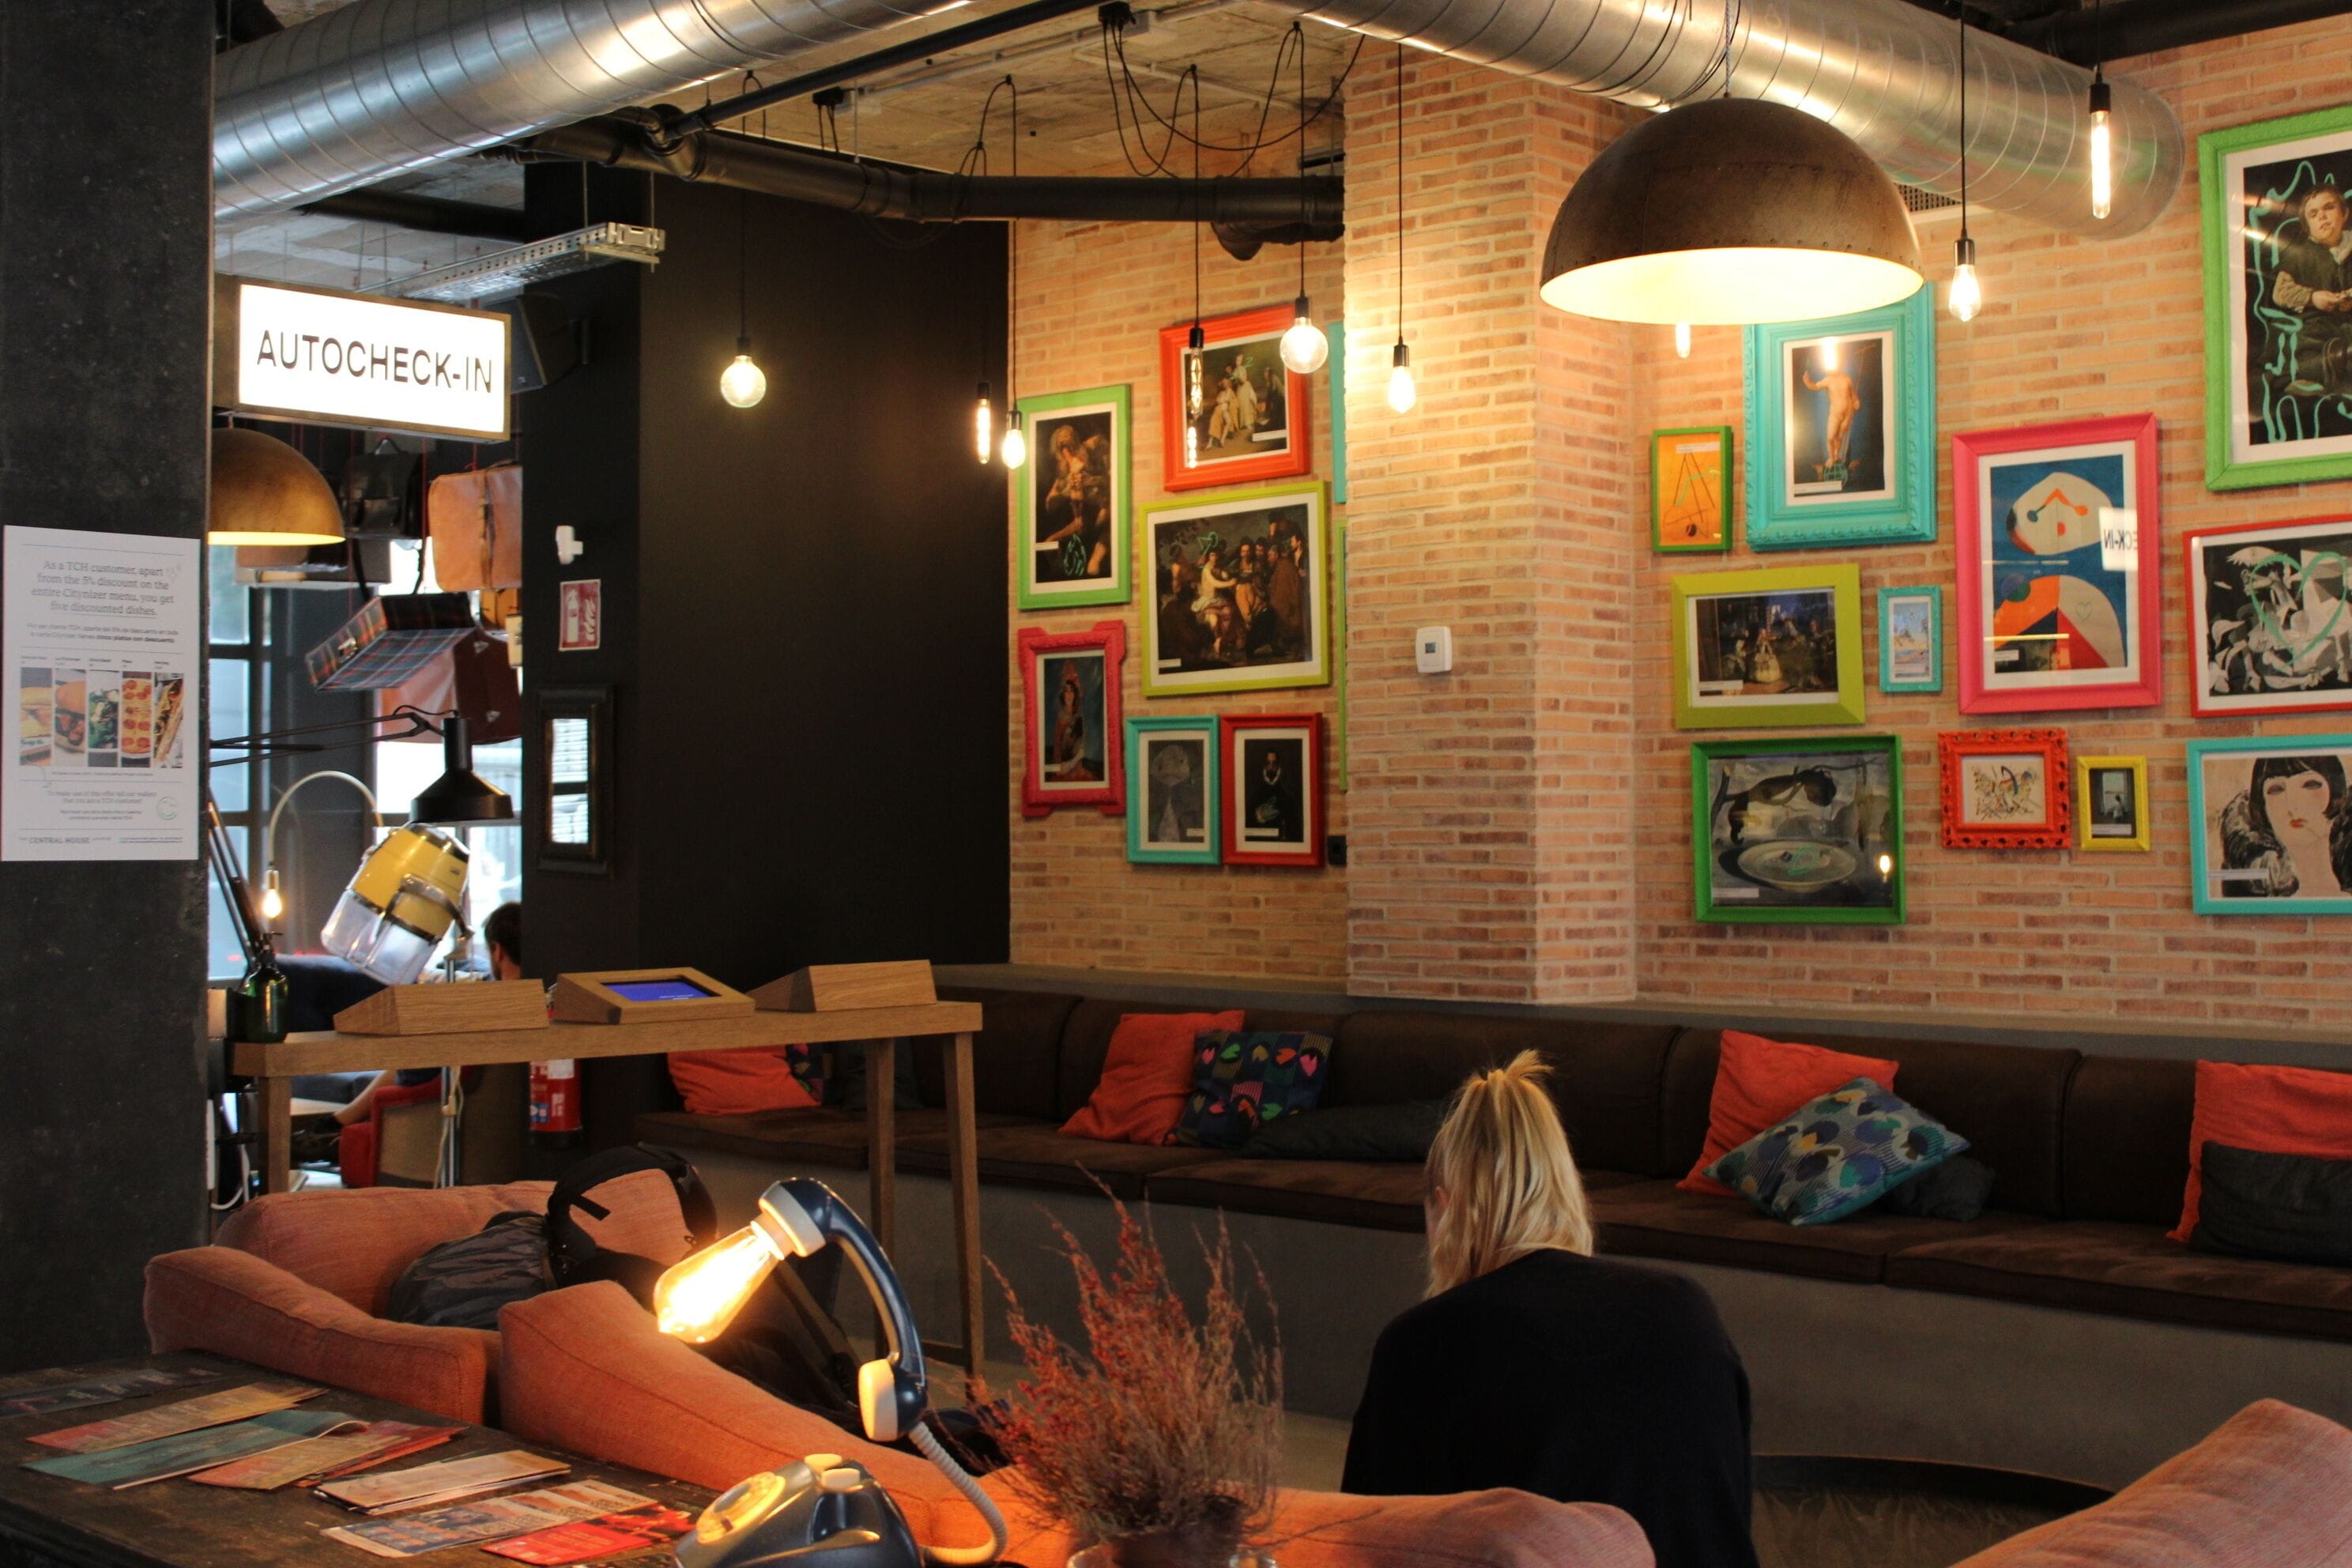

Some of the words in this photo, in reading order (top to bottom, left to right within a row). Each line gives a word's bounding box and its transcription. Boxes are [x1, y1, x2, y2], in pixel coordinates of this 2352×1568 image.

[257, 330, 492, 394] AUTOCHECK-IN
[66, 561, 89, 571] TCH
[139, 567, 164, 578] apart
[37, 572, 63, 583] from
[64, 575, 80, 584] the
[97, 577, 138, 589] discount
[140, 580, 152, 589] on
[154, 580, 169, 590] the
[32, 587, 62, 597] entire
[140, 594, 158, 604] you
[160, 595, 175, 605] get
[50, 601, 69, 611] five
[70, 601, 124, 614] discounted
